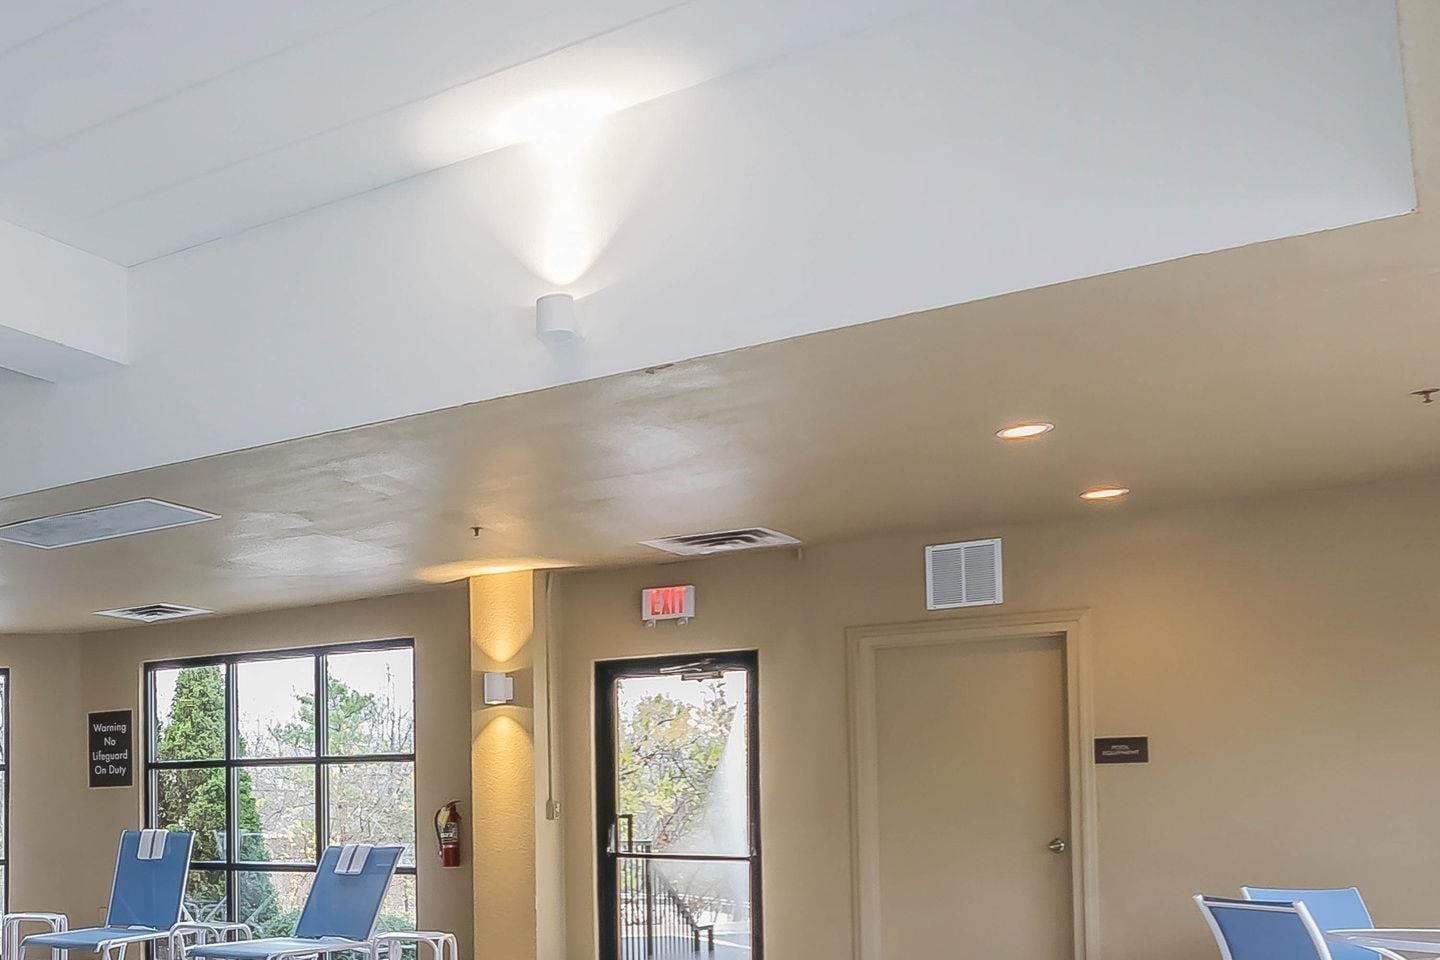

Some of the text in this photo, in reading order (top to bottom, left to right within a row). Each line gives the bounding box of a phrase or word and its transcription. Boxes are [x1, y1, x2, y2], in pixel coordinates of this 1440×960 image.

[651, 587, 685, 615] EXIT
[93, 722, 127, 734] Warning
[103, 736, 116, 746] No
[92, 748, 128, 763] Lifeguard
[94, 764, 127, 777] On Duty
